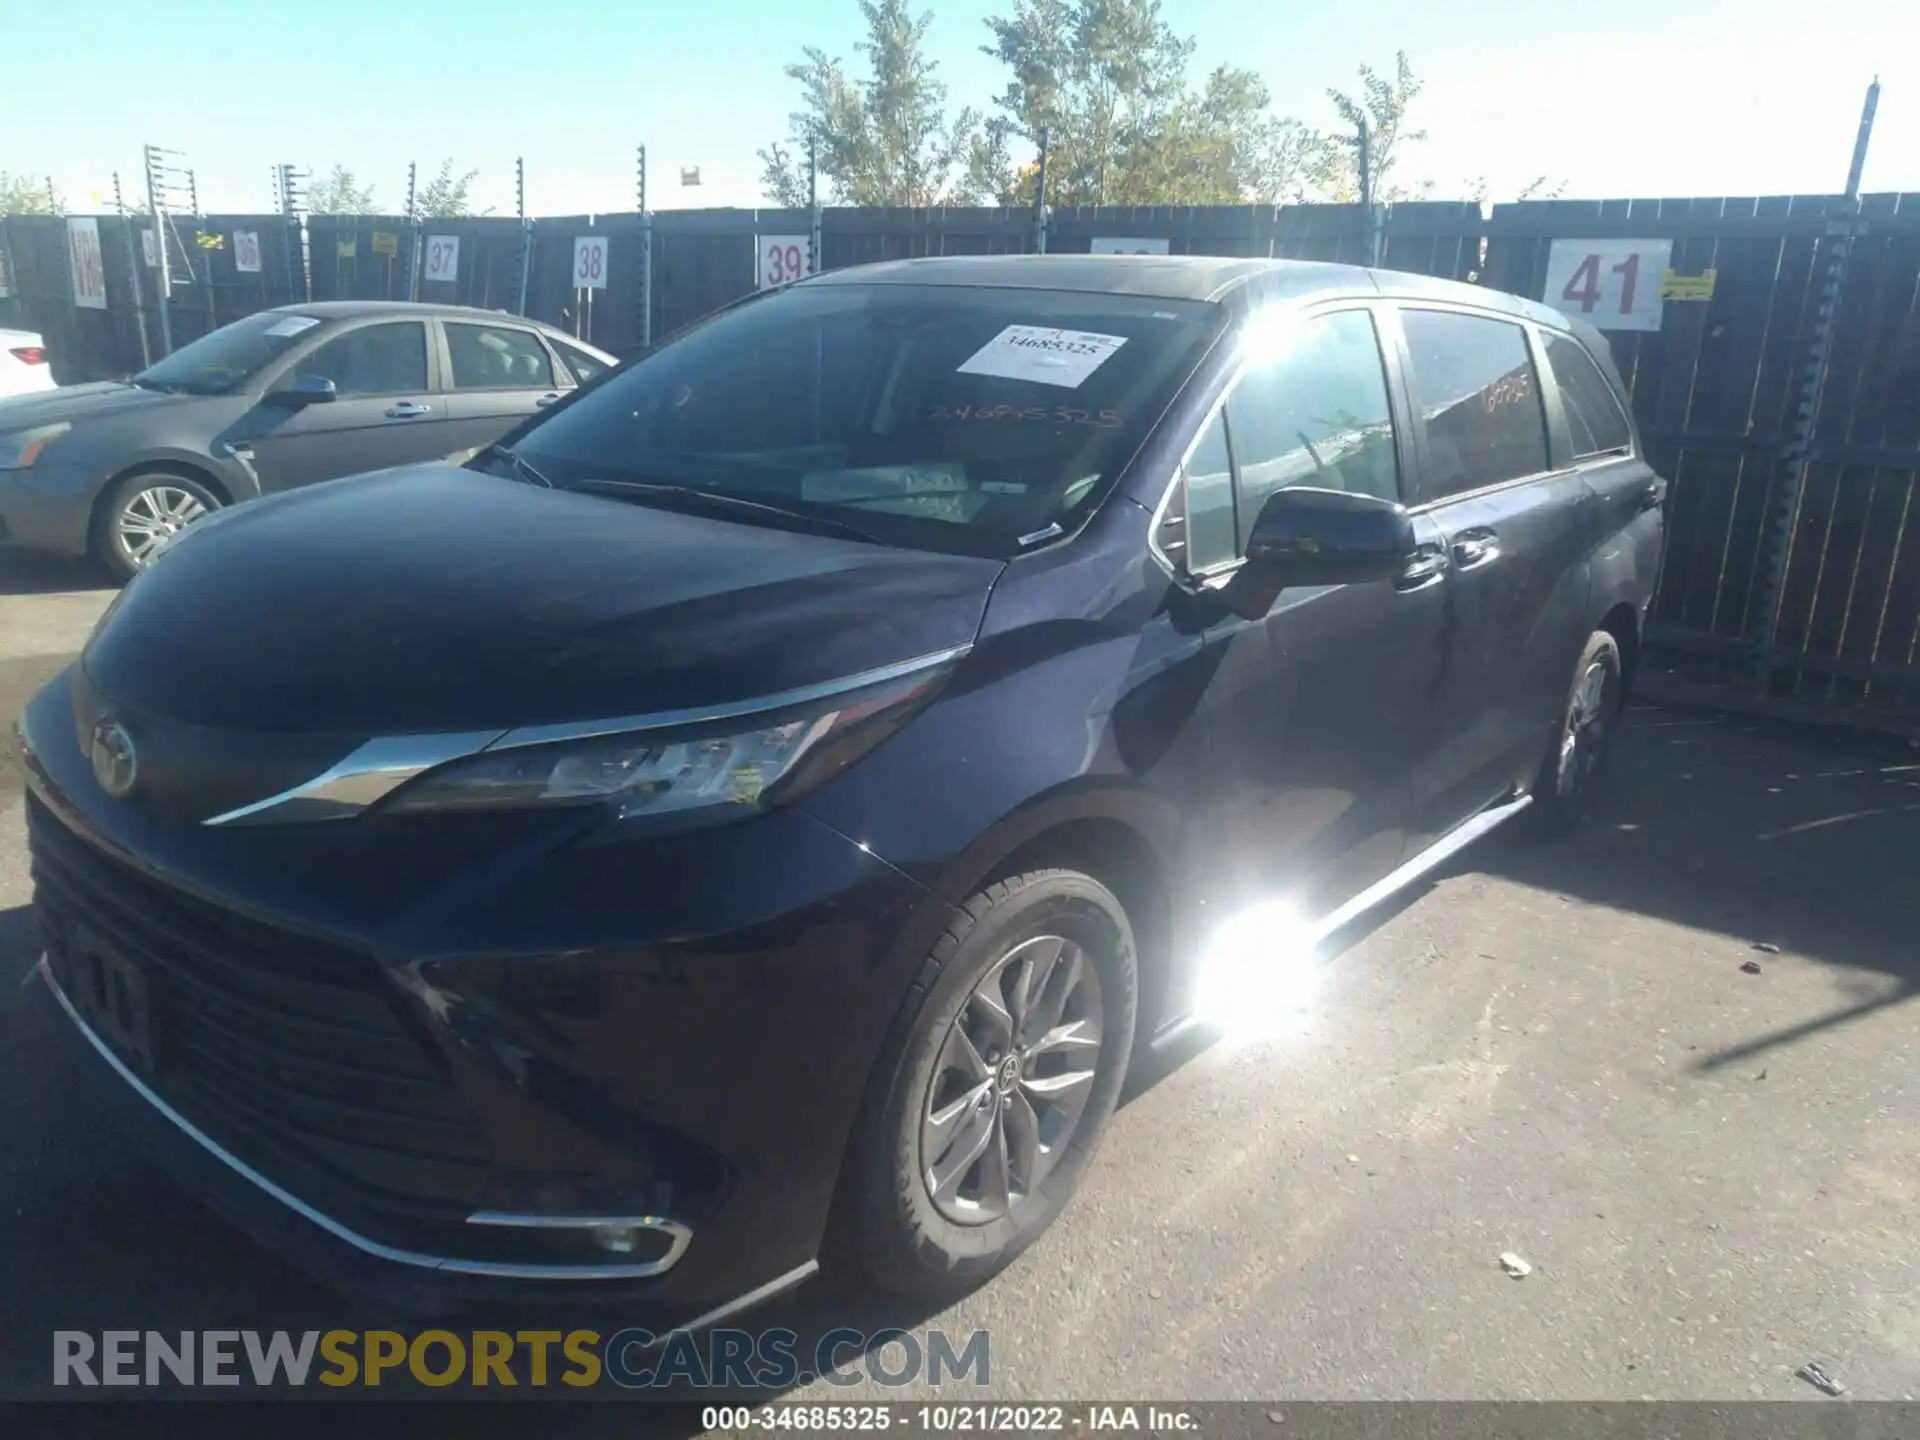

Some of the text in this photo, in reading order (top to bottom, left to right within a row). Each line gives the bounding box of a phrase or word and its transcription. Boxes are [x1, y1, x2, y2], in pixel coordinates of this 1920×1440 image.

[430, 241, 454, 274] 37
[579, 245, 601, 280] 38
[768, 245, 801, 285] 39
[1562, 253, 1640, 315] 41
